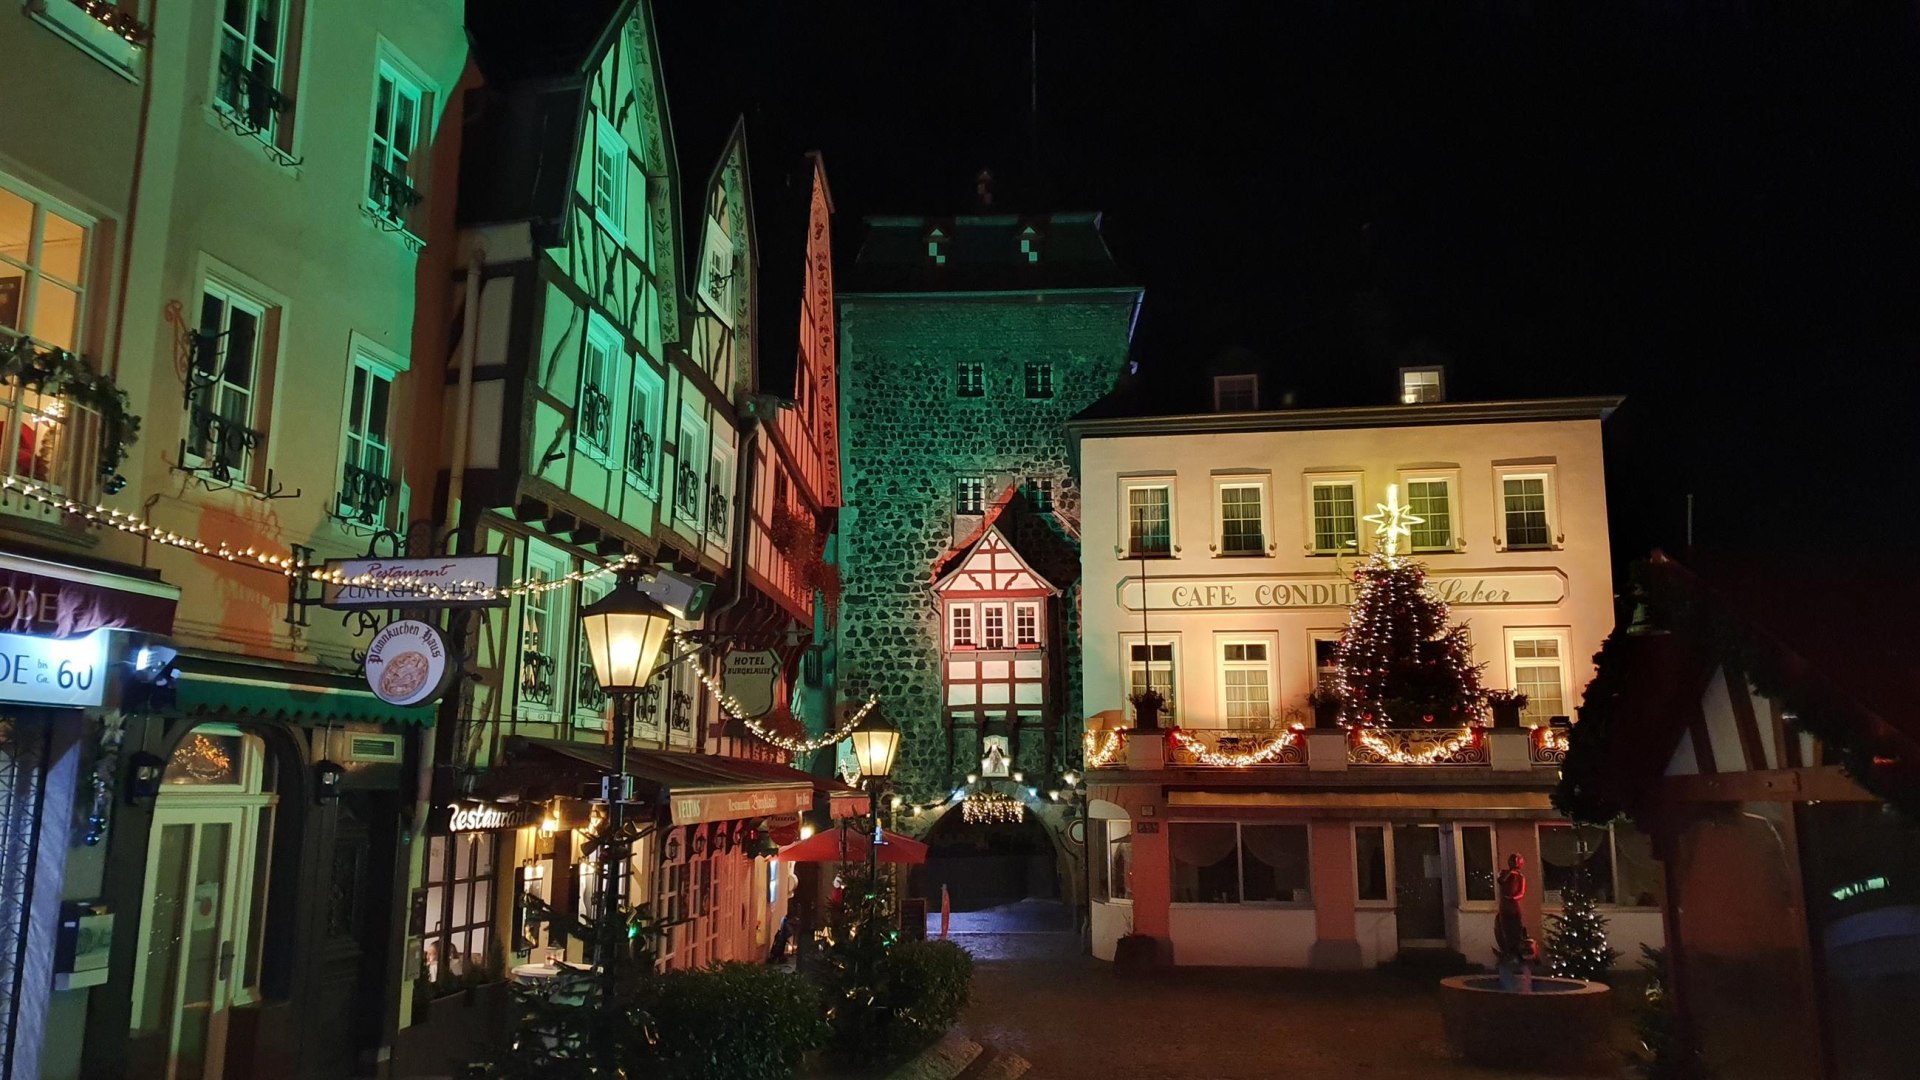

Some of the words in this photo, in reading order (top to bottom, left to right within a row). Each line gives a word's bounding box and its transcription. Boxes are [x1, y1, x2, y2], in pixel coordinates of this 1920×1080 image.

[368, 562, 456, 580] Restaurant
[1172, 586, 1236, 606] CAFE
[1255, 584, 1354, 605] CONDIT
[1439, 579, 1510, 601] Leber
[368, 622, 420, 664] Pfannkuchen
[421, 627, 443, 658] Haus
[733, 656, 766, 665] HOTEL
[57, 659, 93, 691] 60
[447, 804, 531, 832] Restaurant
